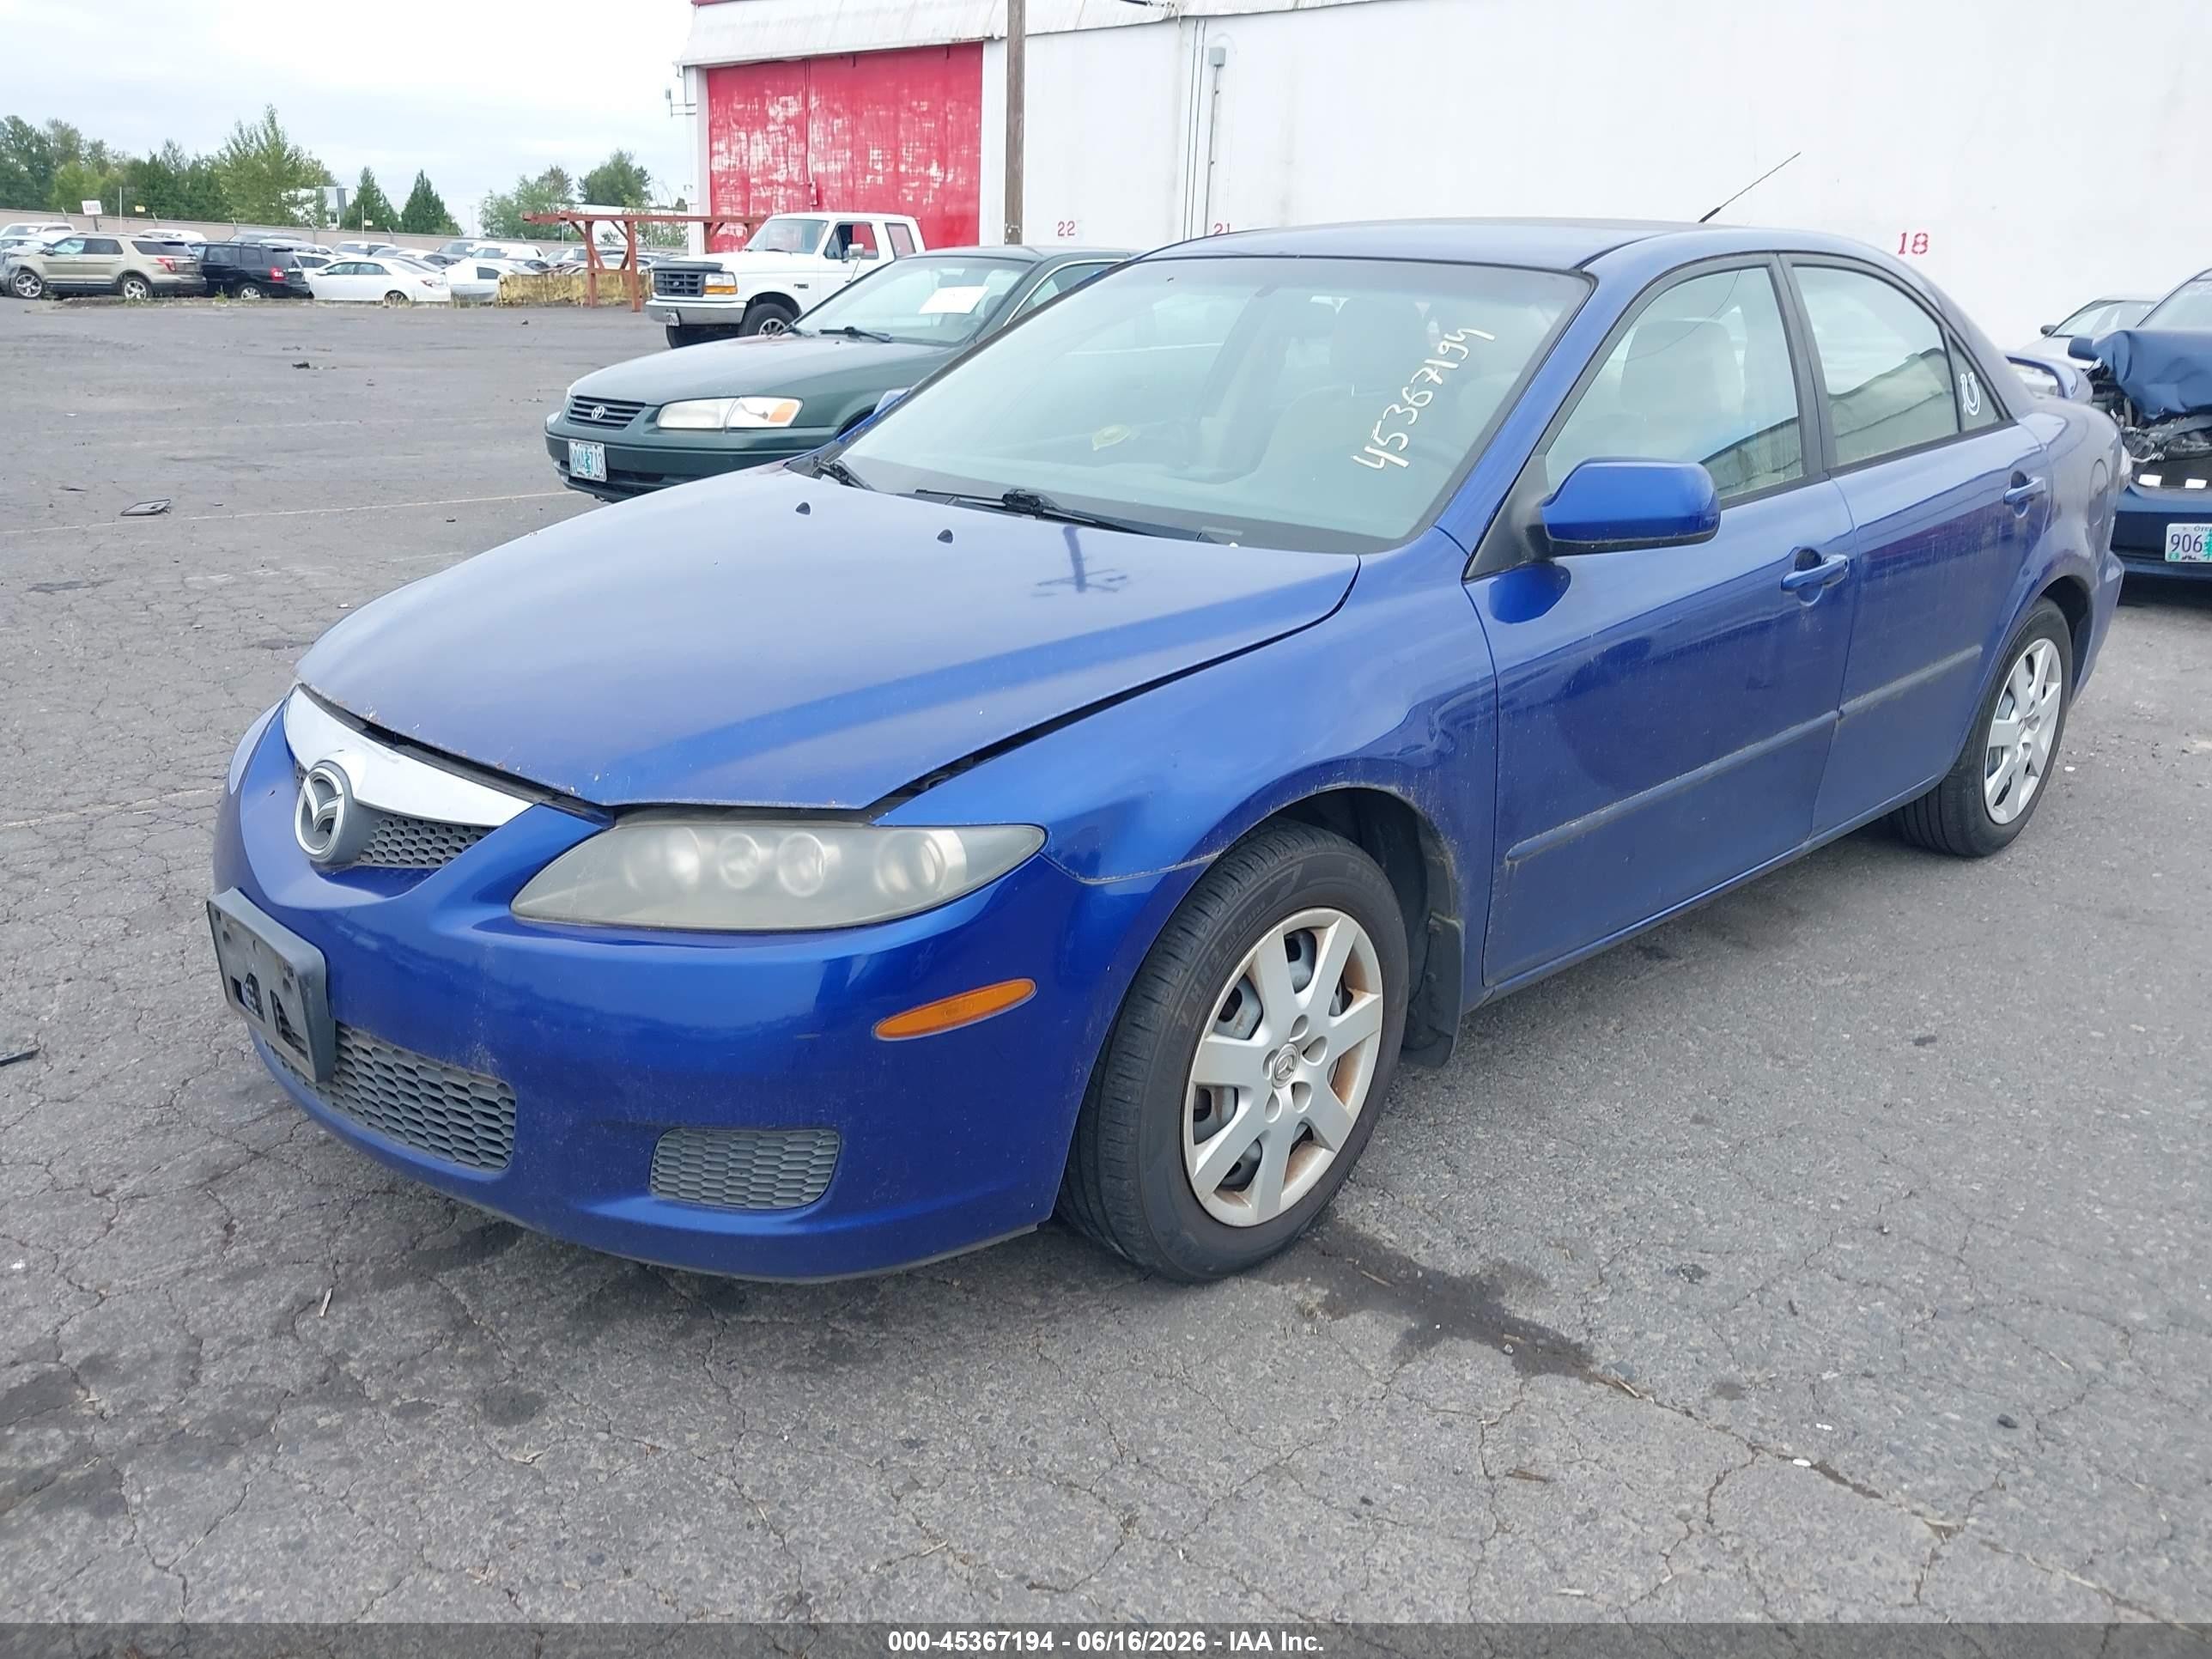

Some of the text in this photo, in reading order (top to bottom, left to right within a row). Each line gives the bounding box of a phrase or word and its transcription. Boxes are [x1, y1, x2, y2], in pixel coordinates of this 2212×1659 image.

[1057, 220, 1076, 237] 22
[1898, 232, 1929, 255] 18
[1351, 328, 1495, 470] 45367194
[2170, 533, 2203, 553] 906
